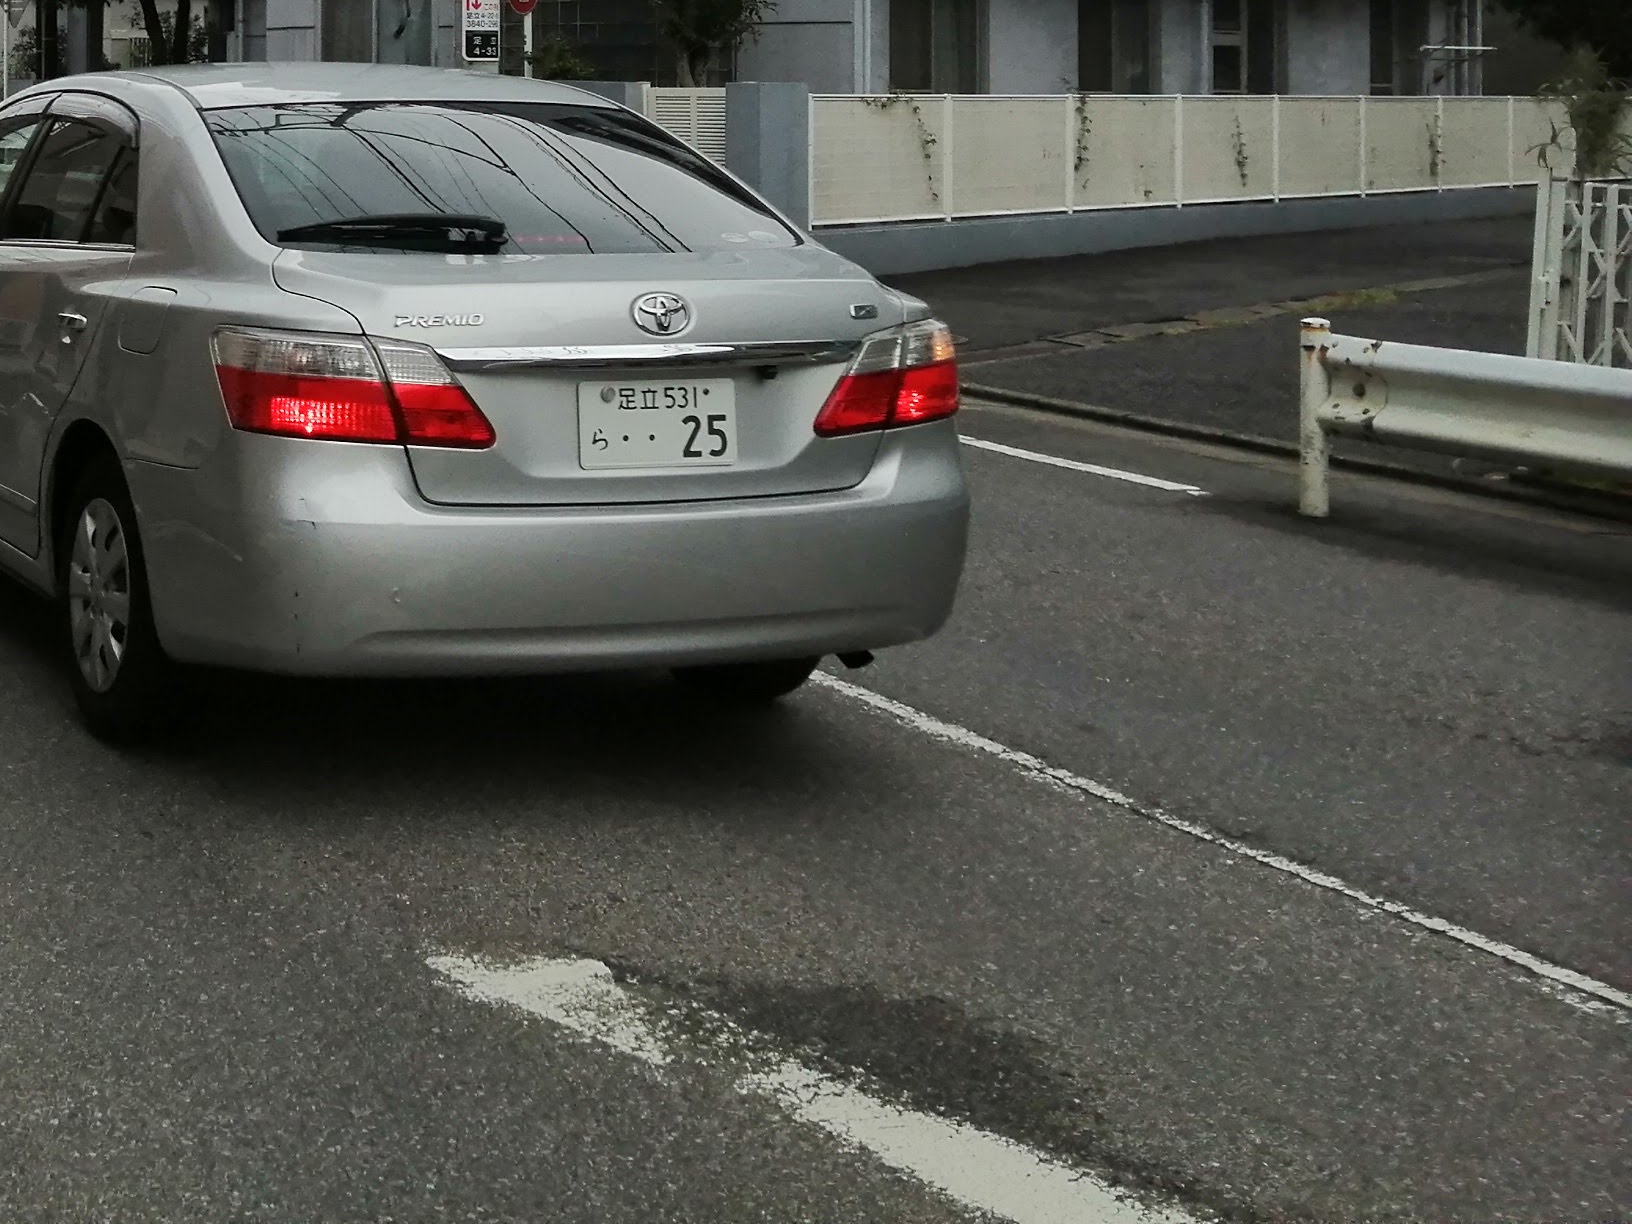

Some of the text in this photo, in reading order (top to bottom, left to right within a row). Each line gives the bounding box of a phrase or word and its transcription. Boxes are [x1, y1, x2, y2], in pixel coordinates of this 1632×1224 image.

[394, 313, 485, 328] PREMIO
[618, 386, 698, 410] 足立 531
[591, 428, 609, 451] ら
